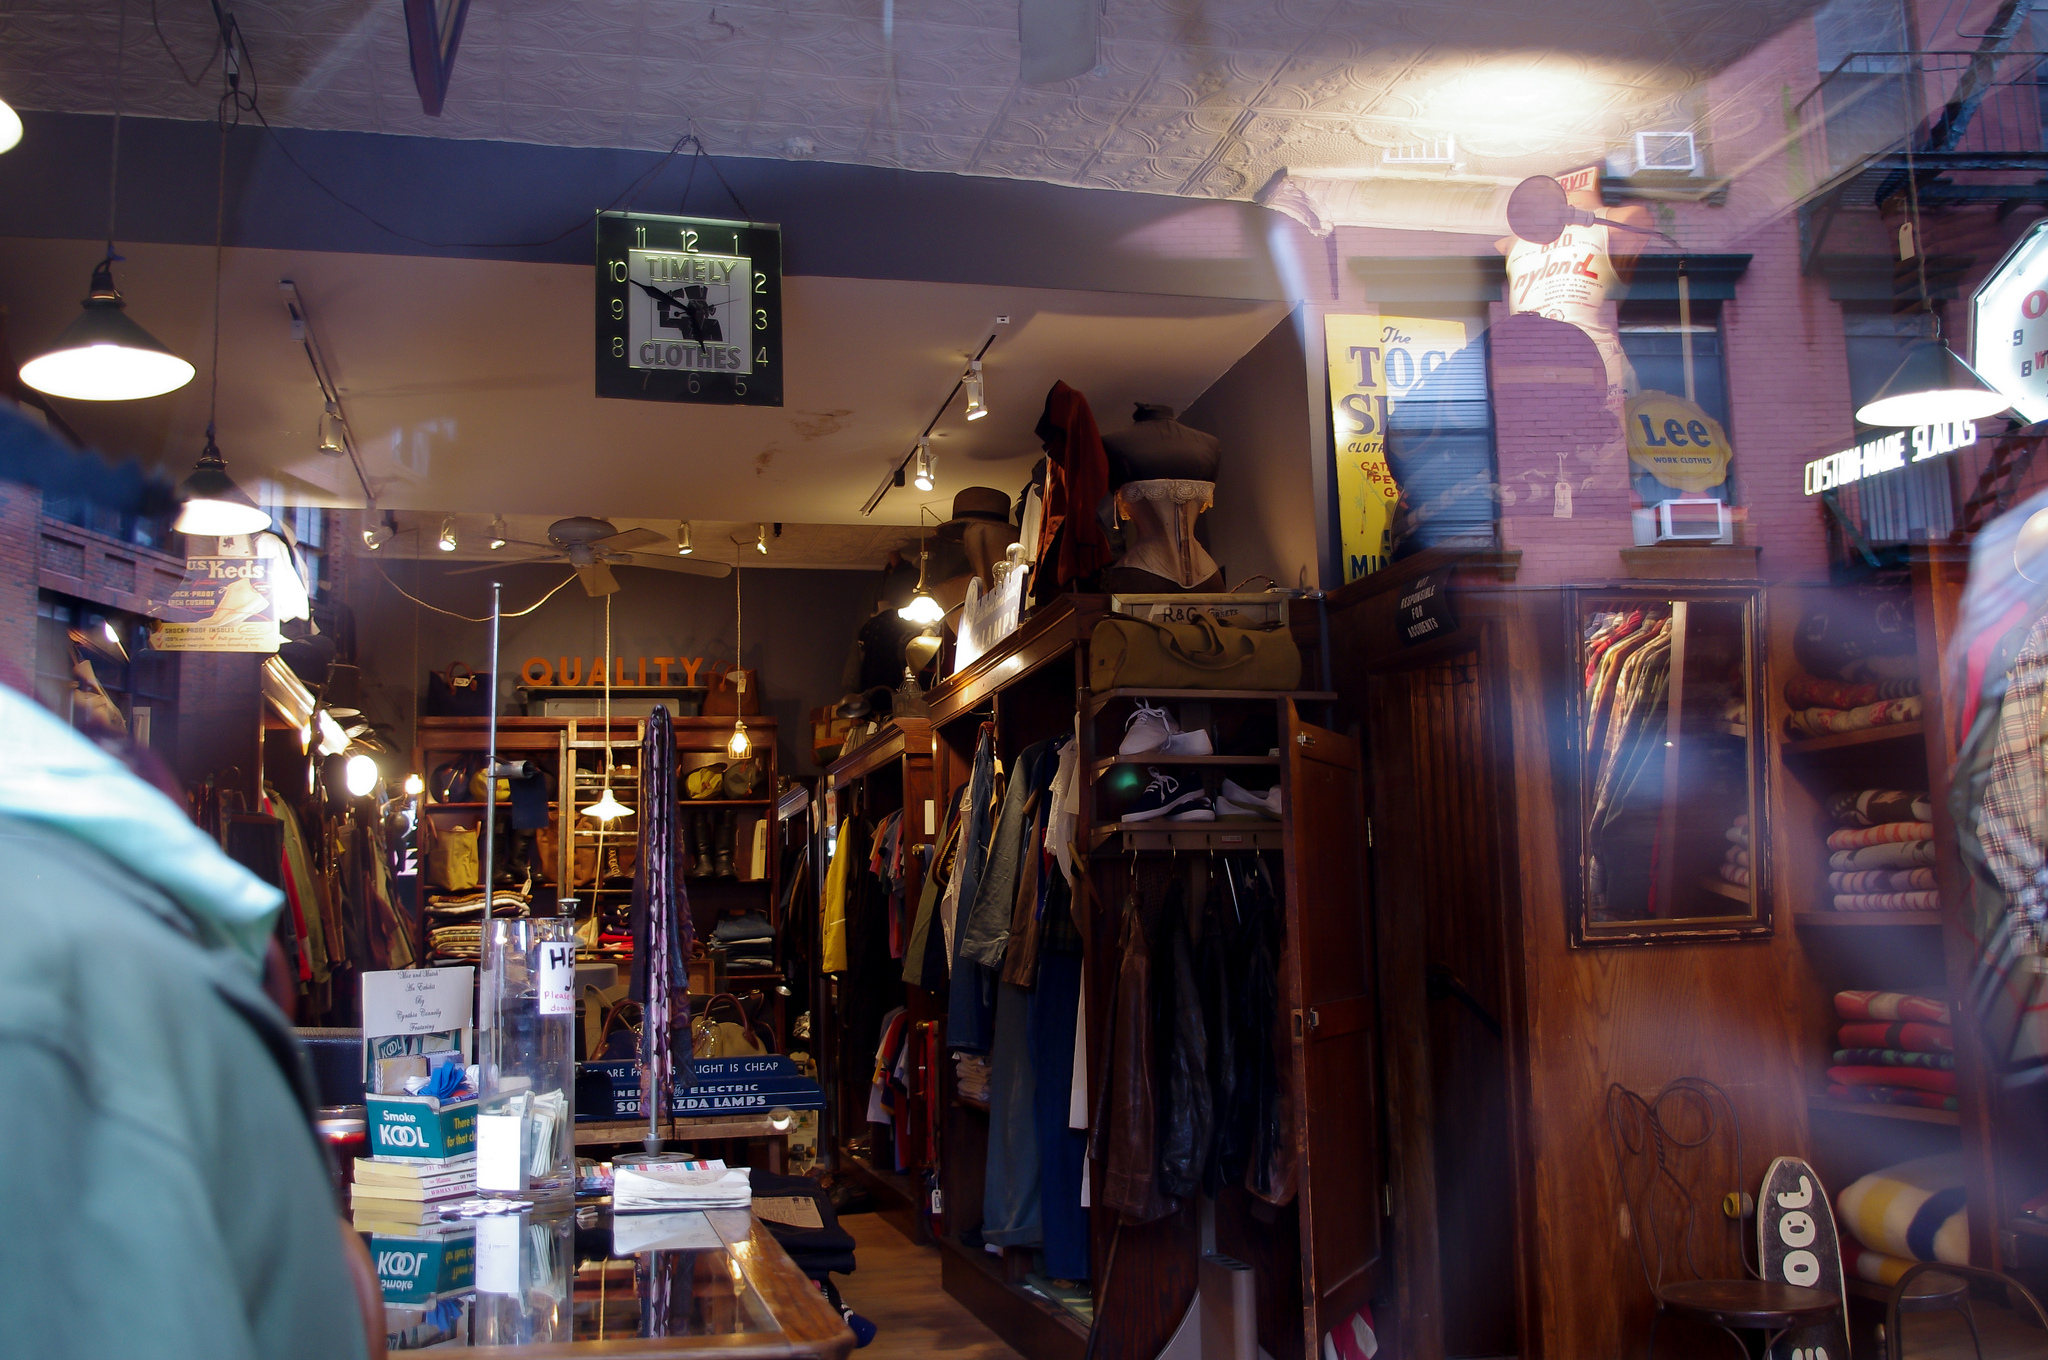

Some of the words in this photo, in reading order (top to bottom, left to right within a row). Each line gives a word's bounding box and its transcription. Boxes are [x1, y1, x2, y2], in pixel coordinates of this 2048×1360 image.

[635, 226, 647, 249] 11
[681, 230, 699, 253] 12
[733, 234, 739, 256] 1
[608, 260, 628, 283] 10
[644, 255, 738, 283] TIMELY
[754, 272, 767, 294] 2
[611, 299, 625, 321] 9
[754, 309, 768, 330] 3
[1379, 326, 1412, 344] The
[2013, 329, 2024, 347] 9
[612, 336, 625, 358] 8
[639, 341, 742, 370] CLOTHES
[755, 346, 769, 368] 4
[2021, 360, 2032, 378] 8
[688, 372, 700, 394] 6
[734, 375, 747, 396] 5
[1637, 414, 1711, 448] Lee
[1653, 456, 1678, 464] WORK
[1680, 457, 1712, 465] CLOTHES
[208, 560, 265, 580] Keds
[185, 599, 215, 607] CUSHION
[1411, 604, 1424, 620] FOR
[1407, 617, 1439, 639] ACCIDENTS
[521, 656, 704, 687] QUALITY
[543, 990, 571, 1001] Please
[380, 1038, 403, 1059] KOOL
[730, 1063, 739, 1074] IS
[744, 1061, 779, 1074] CHEAP
[690, 1083, 759, 1095] ELECTRIC
[714, 1096, 766, 1109] LAMPS
[382, 1110, 417, 1123] Smoke
[453, 1117, 470, 1130] There
[379, 1123, 430, 1148] KOOL
